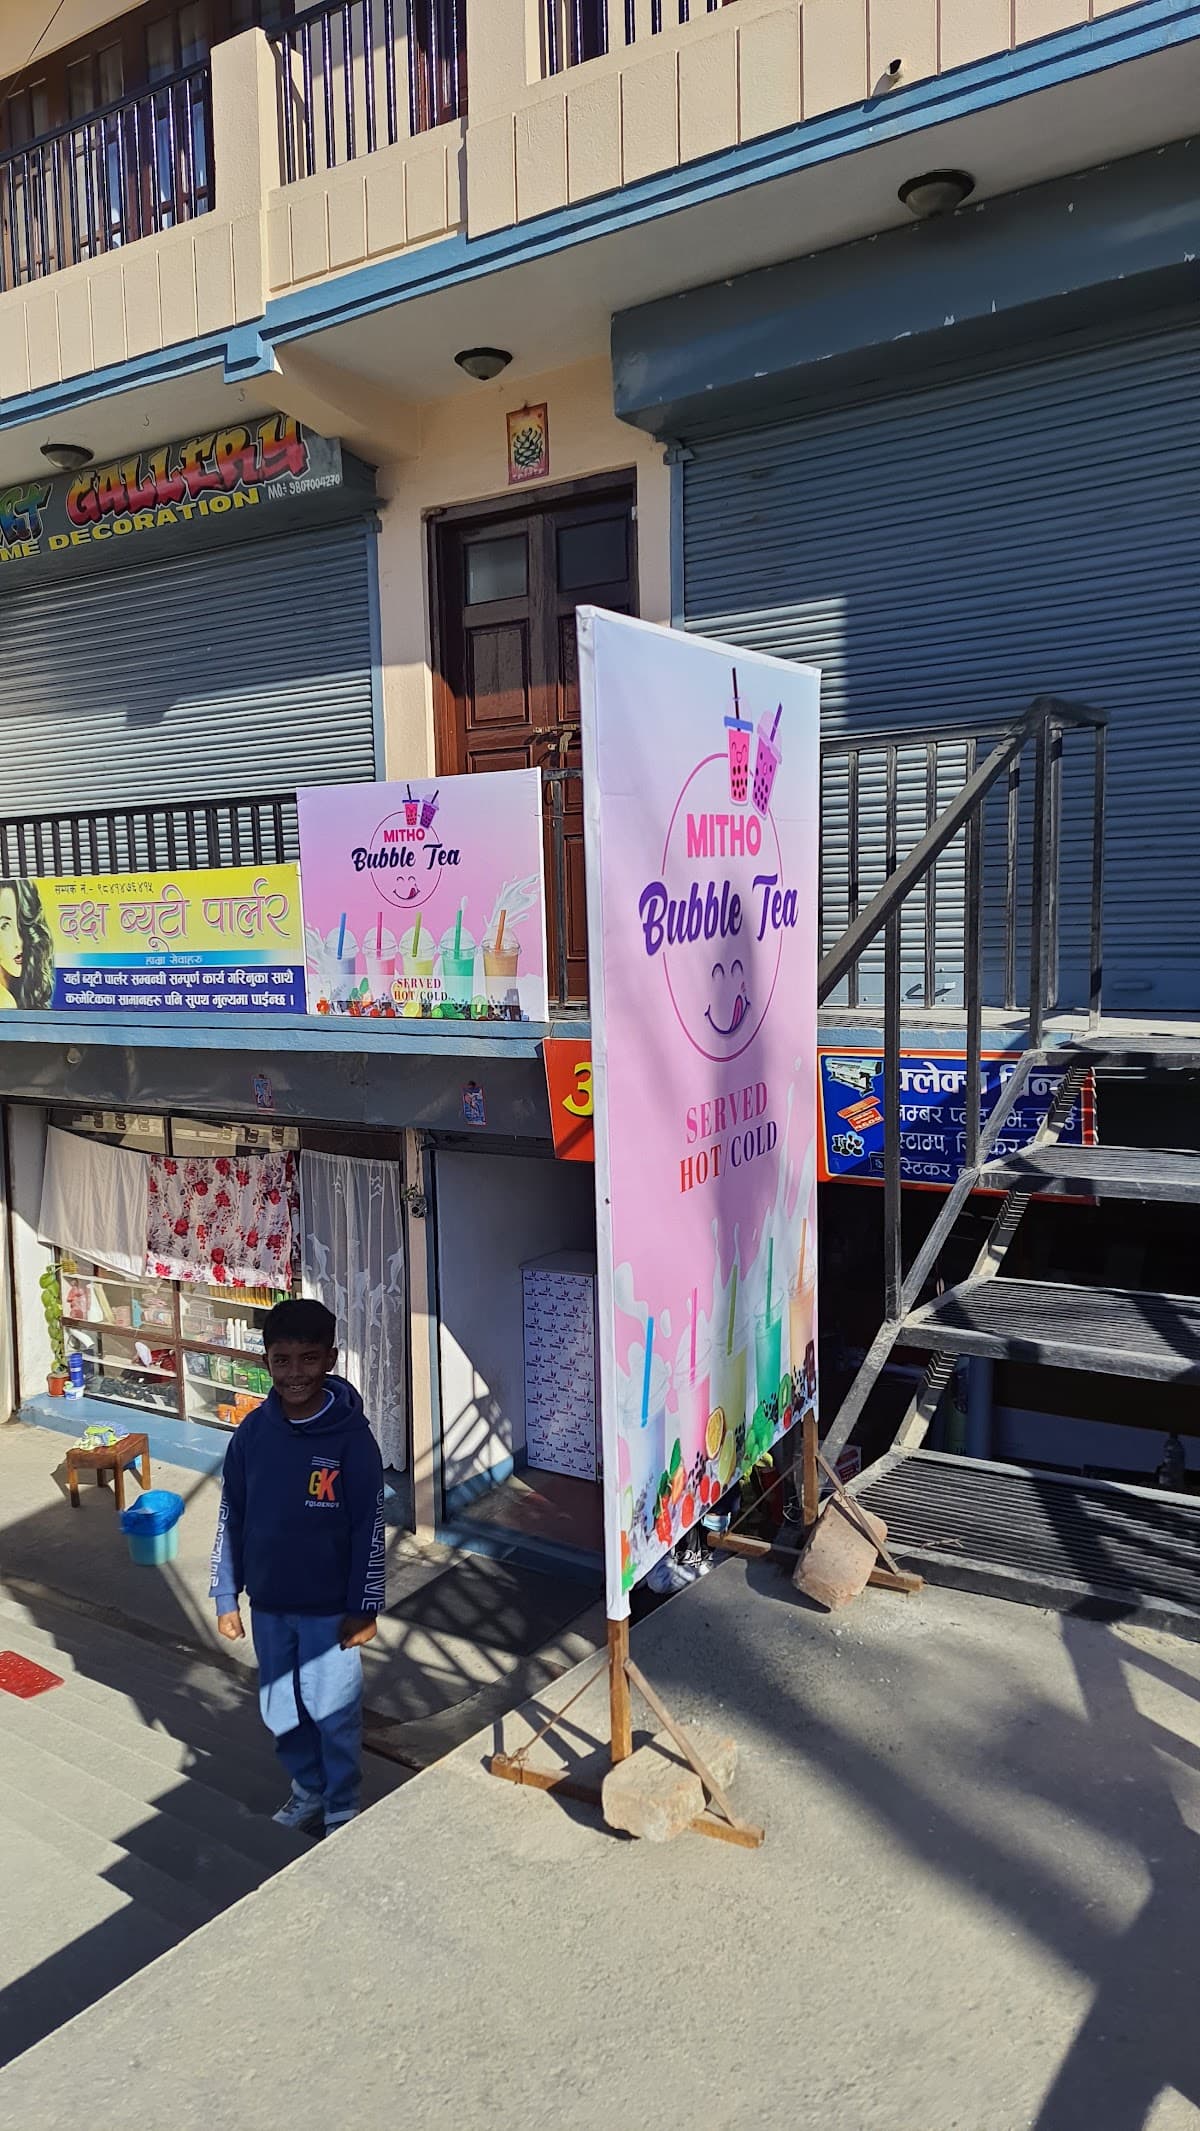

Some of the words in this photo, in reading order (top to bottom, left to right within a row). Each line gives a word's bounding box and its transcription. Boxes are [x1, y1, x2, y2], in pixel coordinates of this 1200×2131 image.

[0, 483, 53, 548] RT
[66, 413, 310, 527] GALLERY
[49, 487, 260, 551] DECORATION
[351, 847, 416, 872] Bubble
[423, 843, 461, 870] Tea
[383, 828, 425, 843] MITHO
[687, 813, 762, 858] MITHO
[58, 899, 111, 943] दक्ष
[201, 877, 291, 937] पार्लर
[638, 880, 743, 957] Bubble
[752, 873, 799, 942] Tea
[397, 977, 442, 989] SERVED
[686, 1081, 768, 1145] SERVED
[308, 1468, 339, 1501] GK
